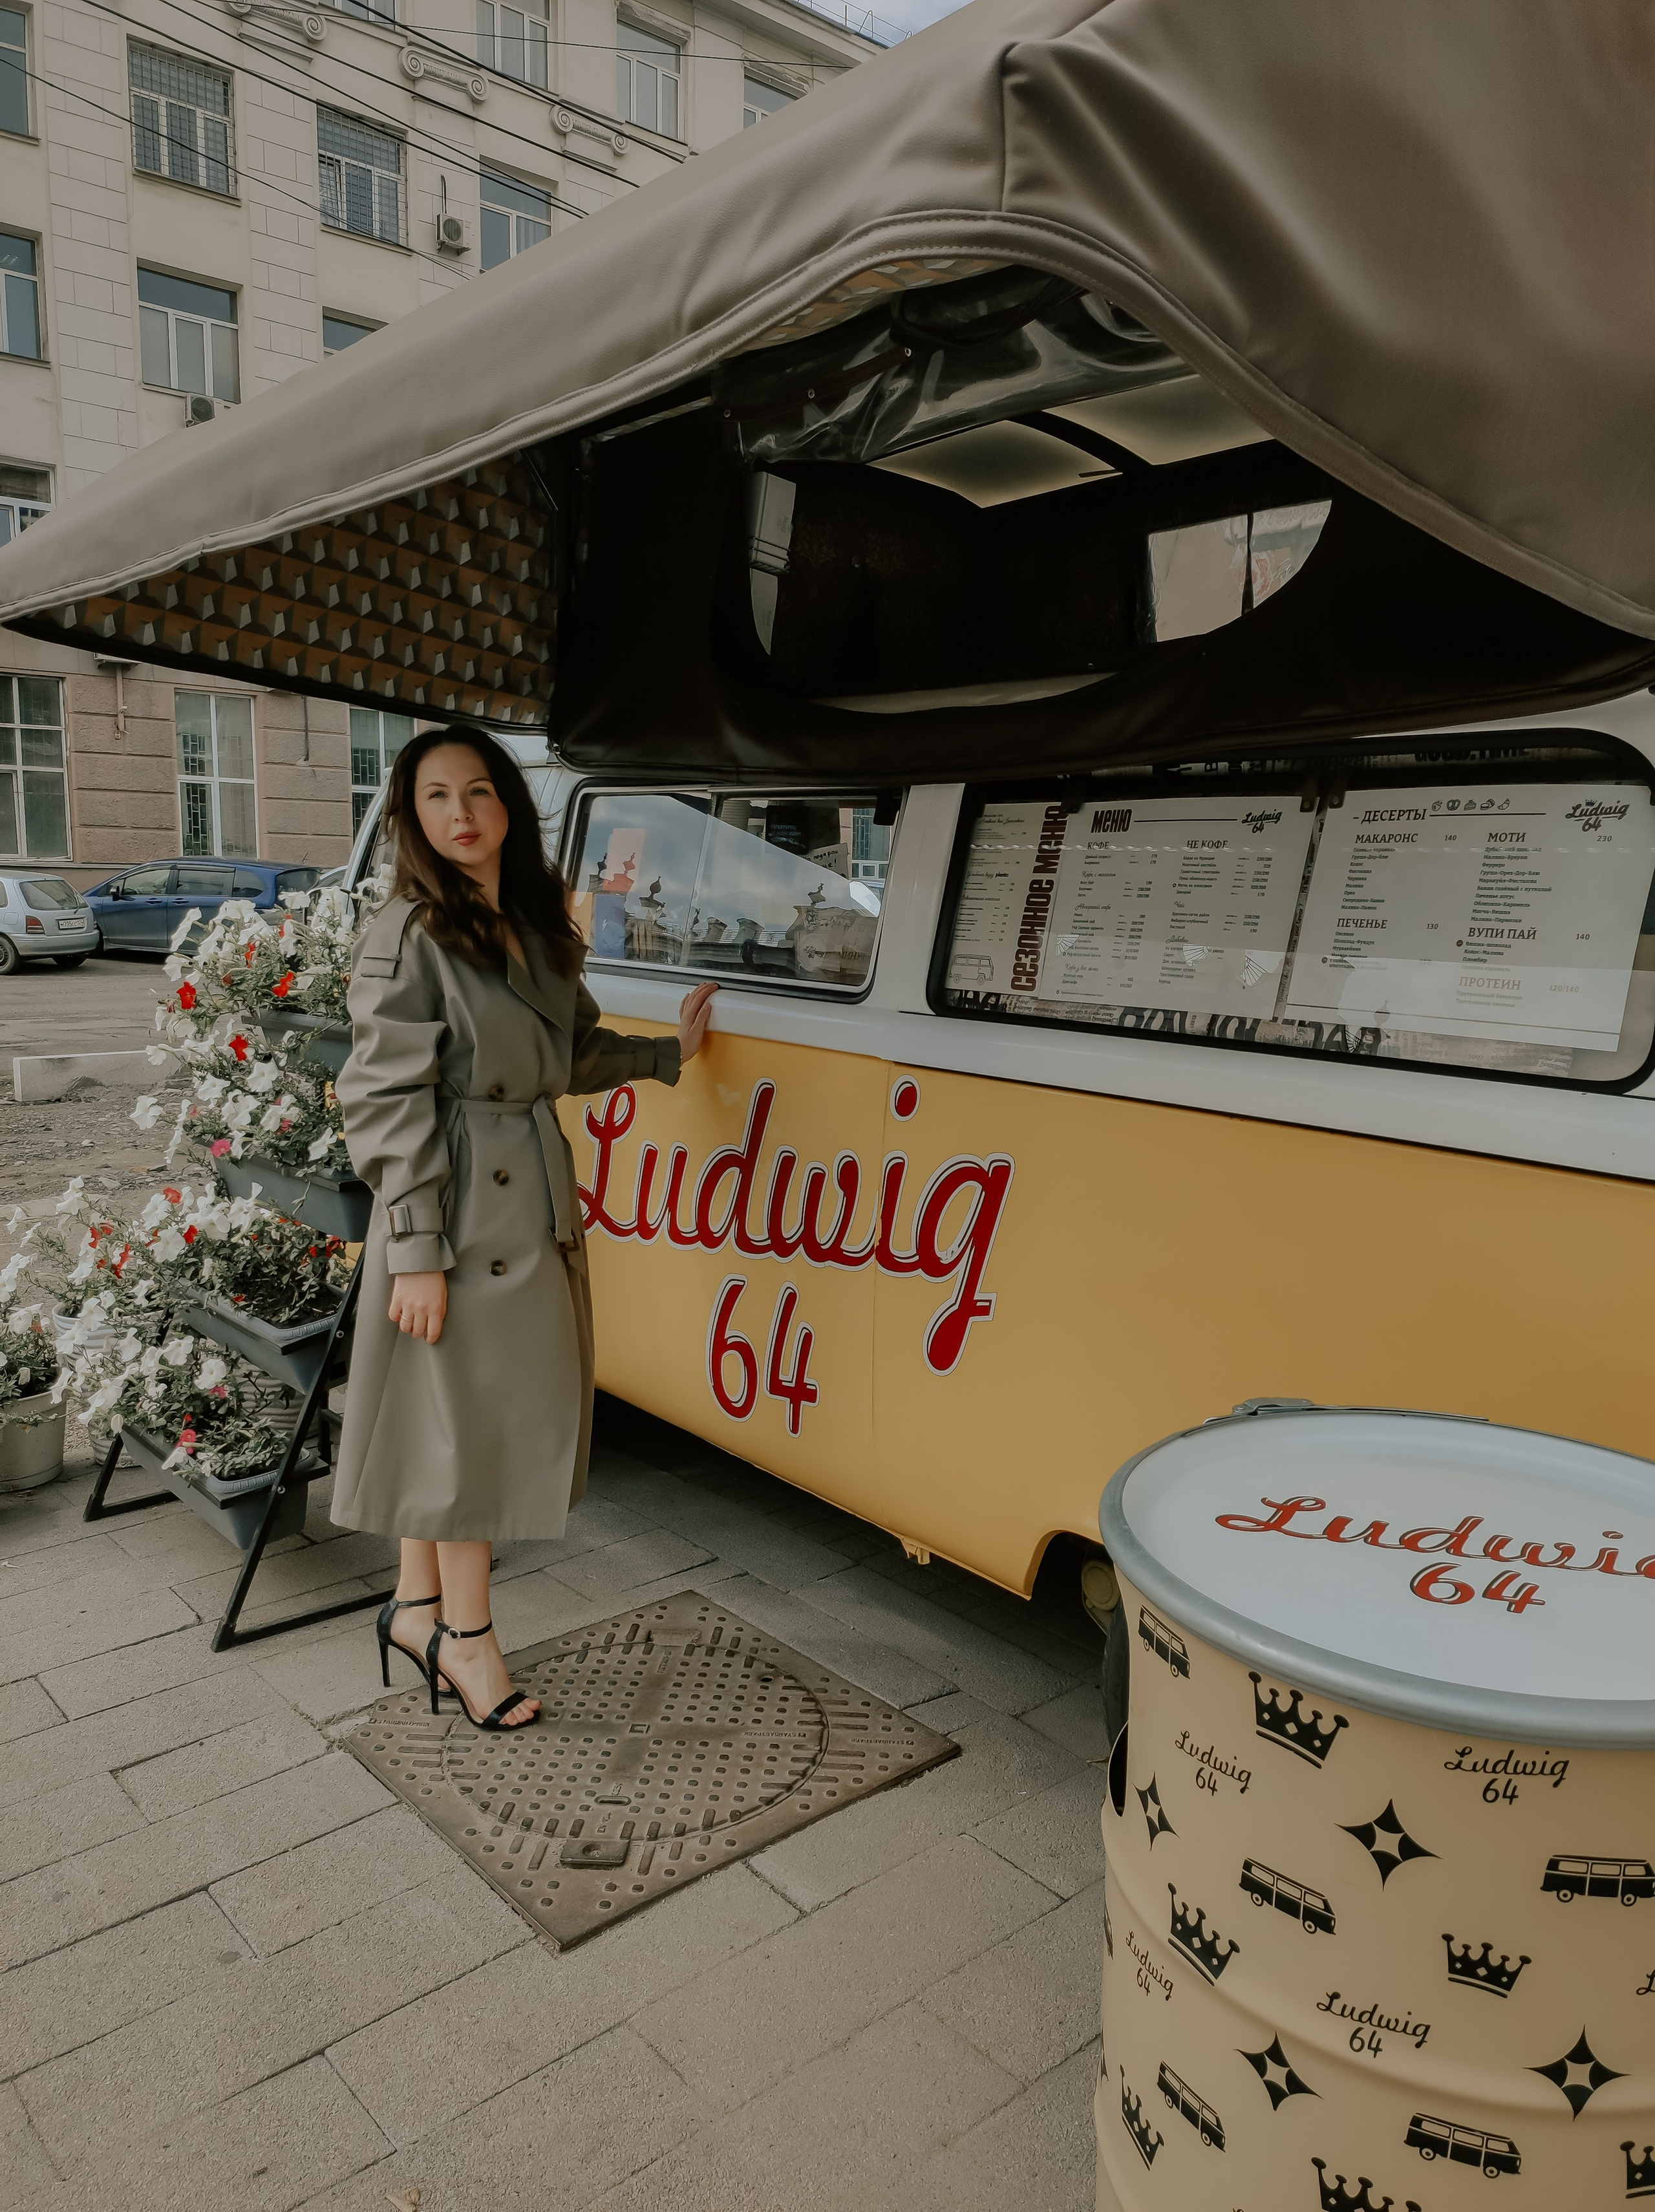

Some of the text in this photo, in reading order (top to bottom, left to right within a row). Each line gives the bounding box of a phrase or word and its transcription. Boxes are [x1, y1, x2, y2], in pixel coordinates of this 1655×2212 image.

[1241, 808, 1282, 824] Ludwig
[1361, 809, 1427, 824] ДЕСЕРТЫ
[1565, 800, 1630, 821] Ludwig
[1252, 821, 1265, 833] 64
[1582, 817, 1602, 832] 64
[1354, 833, 1418, 843] МАКАРОНС
[1487, 832, 1526, 843] МОТИ
[1336, 918, 1388, 929] ПЕЧЕНЬЕ
[1468, 927, 1538, 940] ВУПИ ПАЙ
[1575, 932, 1590, 941] 140
[1458, 976, 1521, 990] ПРОТЕИН
[1549, 984, 1579, 993] 120/140
[577, 1075, 1016, 1376] Ludwig
[705, 1273, 820, 1438] 64
[1410, 1562, 1546, 1615] 64
[1175, 1730, 1252, 1794] Ludwig
[1444, 1745, 1570, 1788] Ludwig
[1195, 1766, 1219, 1797] 64
[1482, 1778, 1520, 1806] 64
[1125, 1929, 1175, 2002] Ludwig
[1135, 1969, 1151, 1997] 64
[1316, 1991, 1431, 2049] Ludwig
[1349, 2026, 1383, 2059] 64
